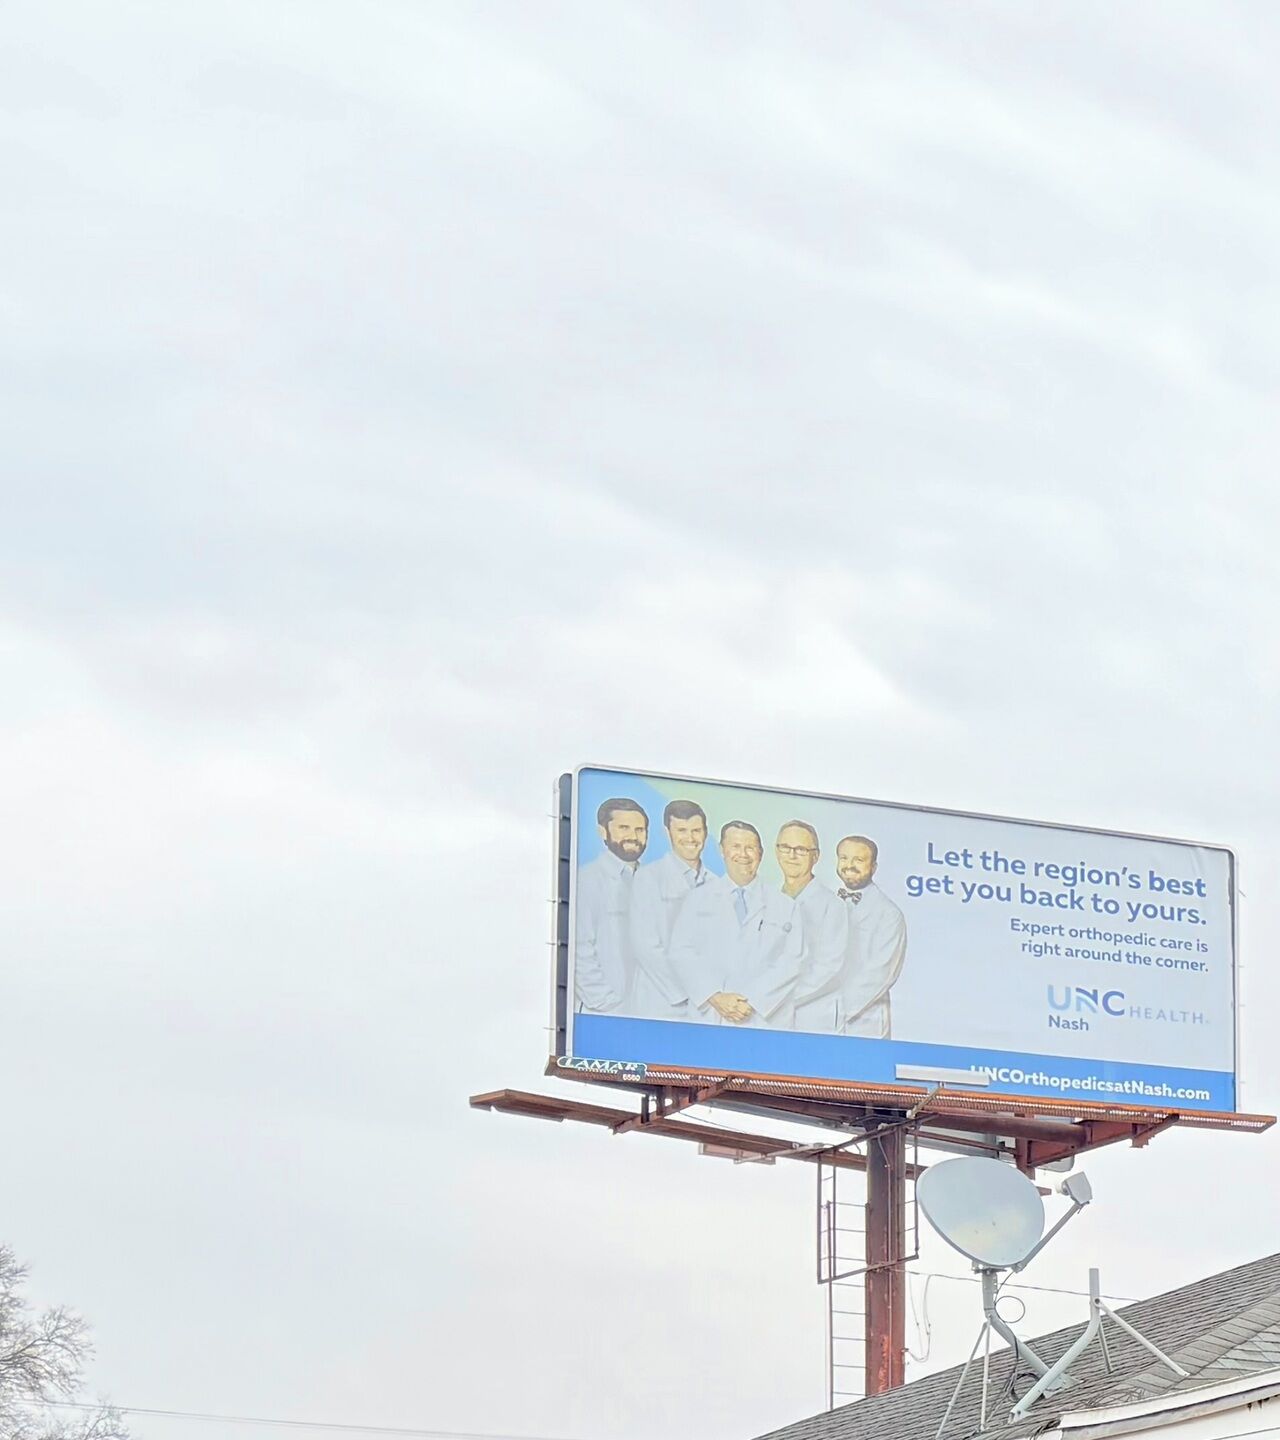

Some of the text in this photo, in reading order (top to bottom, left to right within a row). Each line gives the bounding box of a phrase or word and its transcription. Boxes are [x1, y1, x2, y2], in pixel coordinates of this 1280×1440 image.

[927, 842, 1207, 898] Let the region's best
[905, 874, 1207, 925] get you back to yours.
[1010, 918, 1209, 953] Expert orthopedic care is
[1021, 939, 1209, 972] right around the corner.
[1047, 984, 1126, 1017] UNC
[1048, 1014, 1090, 1031] Nash
[565, 1057, 639, 1071] LAMAR
